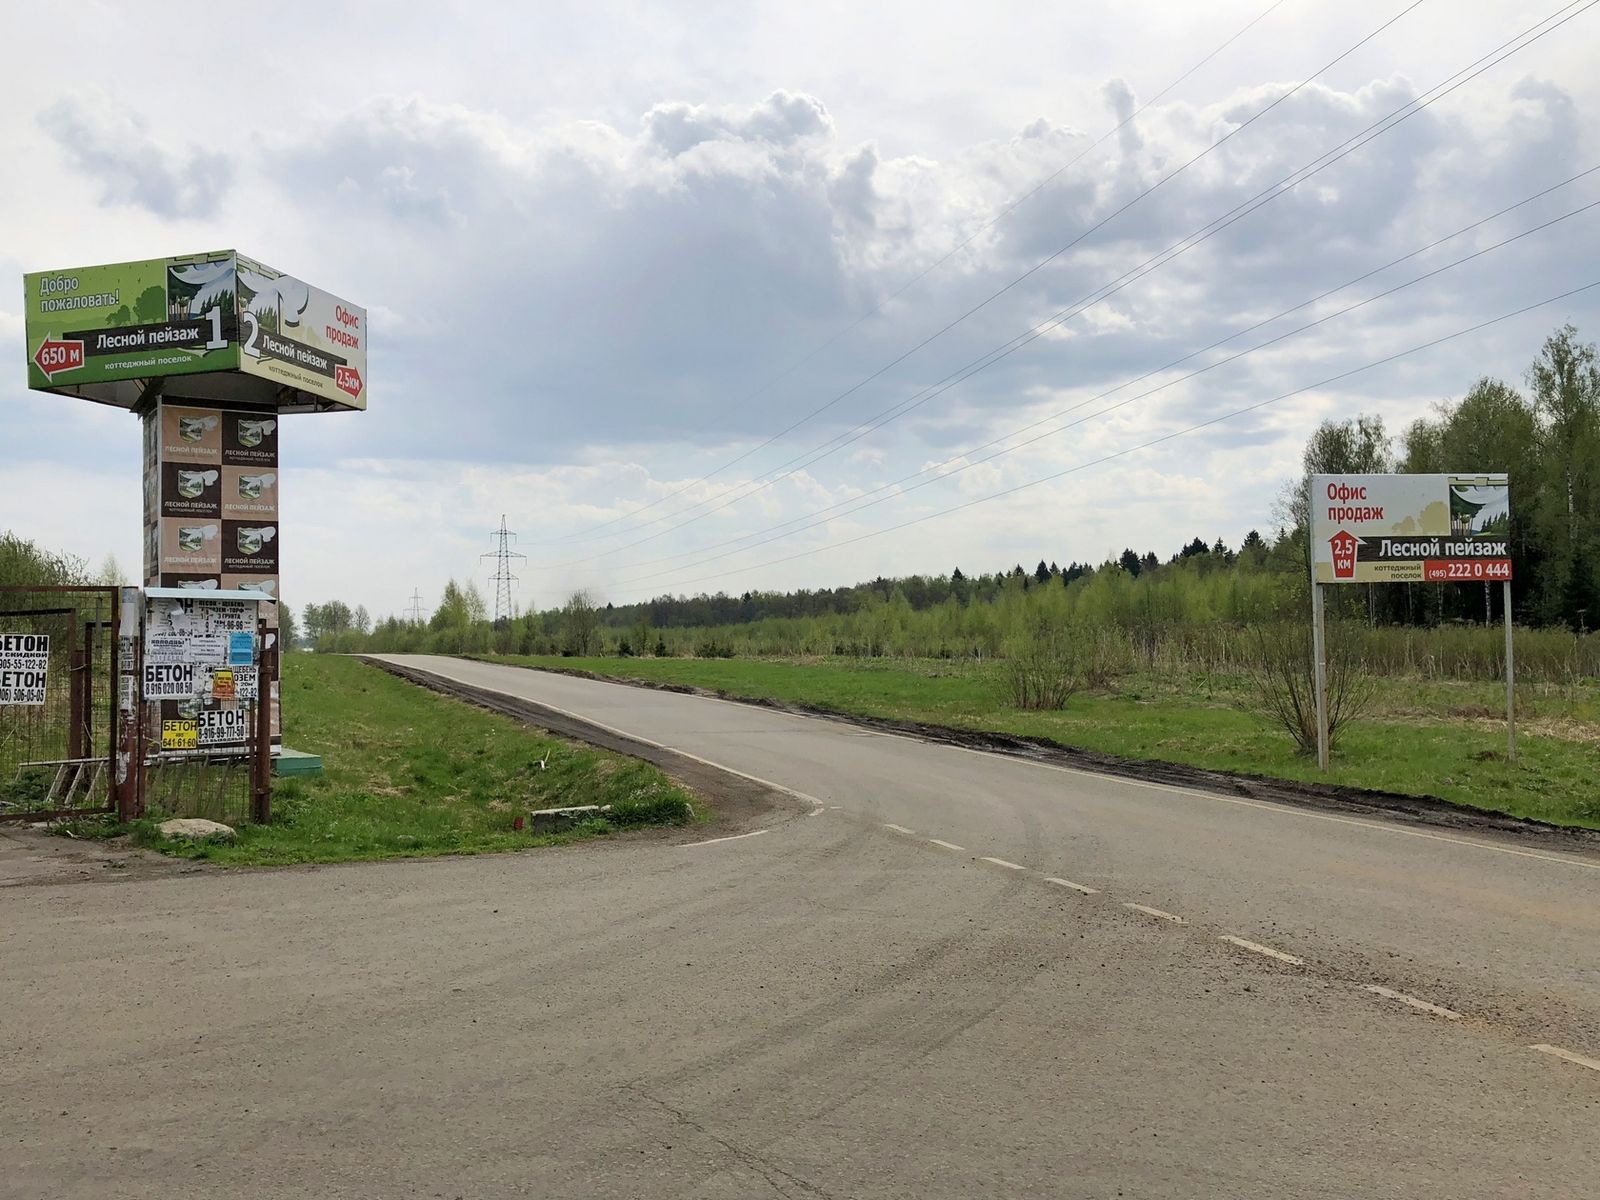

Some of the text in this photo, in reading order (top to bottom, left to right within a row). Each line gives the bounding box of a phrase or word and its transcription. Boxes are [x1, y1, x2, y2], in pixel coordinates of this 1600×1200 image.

[39, 274, 79, 297] Добро
[41, 288, 120, 313] пожаловать!
[335, 305, 359, 329] Офис
[205, 305, 229, 350] 1
[243, 311, 261, 358] 2
[96, 326, 199, 349] Лесной пейзаж
[326, 325, 359, 350] продаж
[41, 346, 80, 366] 650 м
[262, 334, 328, 370] Лесной пейзаж
[104, 354, 193, 370] коттеджный поселок
[268, 365, 324, 388] коттеджный поселок
[249, 450, 276, 458] ПЕЙЗАЖ
[1327, 482, 1367, 505] Офис
[164, 500, 218, 509] ЛЕСНОЙ ПЕЙЗАЖ
[249, 503, 276, 511] ПЕЙЗАЖ
[1328, 506, 1384, 524] продаж
[1334, 539, 1353, 558] 2,5
[1379, 538, 1507, 557] Лесной пейзаж
[249, 557, 275, 565] ПЕЙЗАЖ
[1337, 560, 1351, 570] км
[1374, 563, 1422, 573] коттеджный
[1428, 563, 1510, 579] (495) 222 0 444
[0, 635, 48, 652] ЕТОН
[145, 664, 193, 682] БЕТОН
[145, 681, 193, 695] 8 916 020 08 50
[163, 721, 197, 732] БЕТОН
[197, 709, 245, 728] БЕТОН
